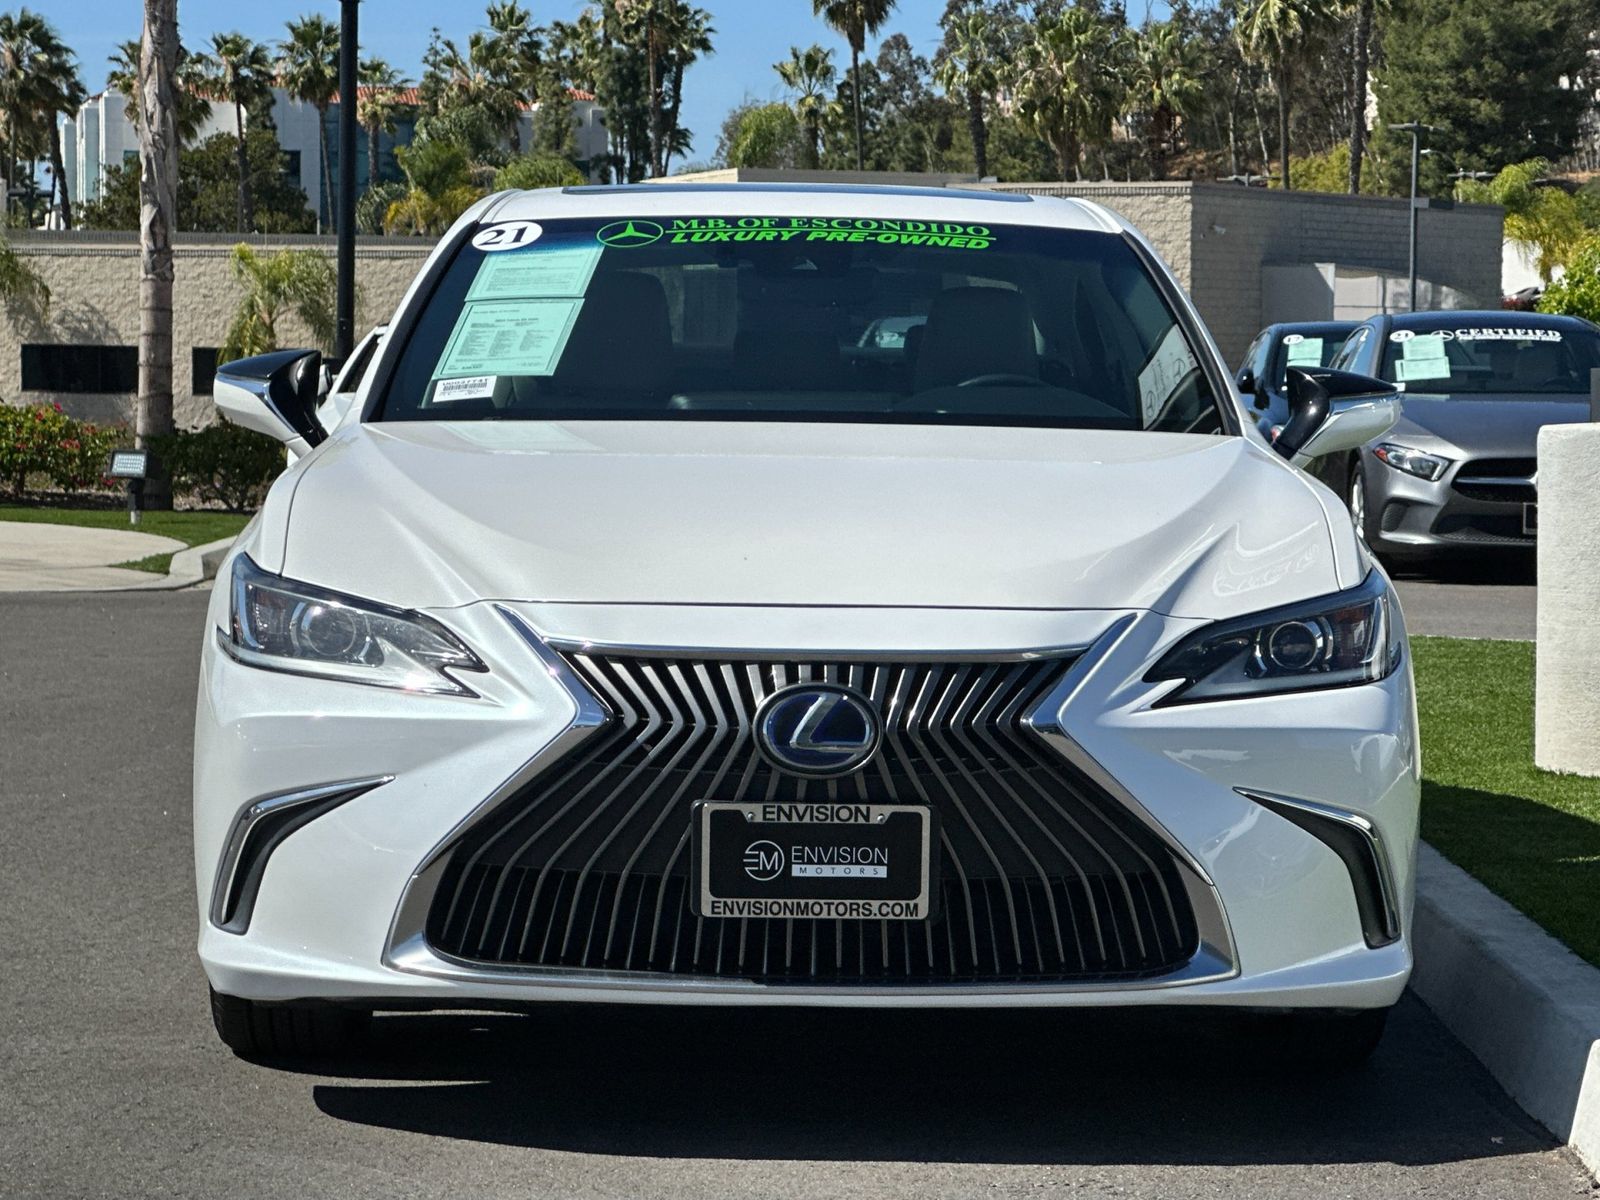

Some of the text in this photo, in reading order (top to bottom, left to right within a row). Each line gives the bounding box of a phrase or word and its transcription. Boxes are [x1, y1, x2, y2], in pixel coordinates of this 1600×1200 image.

[479, 226, 529, 246] 21
[673, 218, 990, 236] M.B. OF ESCONDIDO
[671, 231, 990, 249] LUXURY PRE-OWNED
[1455, 328, 1561, 338] CERTIFIED
[762, 805, 871, 823] ENVISION
[791, 846, 888, 864] ENVISION
[799, 867, 879, 875] MOTORS
[711, 901, 919, 917] ENVISIONMOTORS.COM
